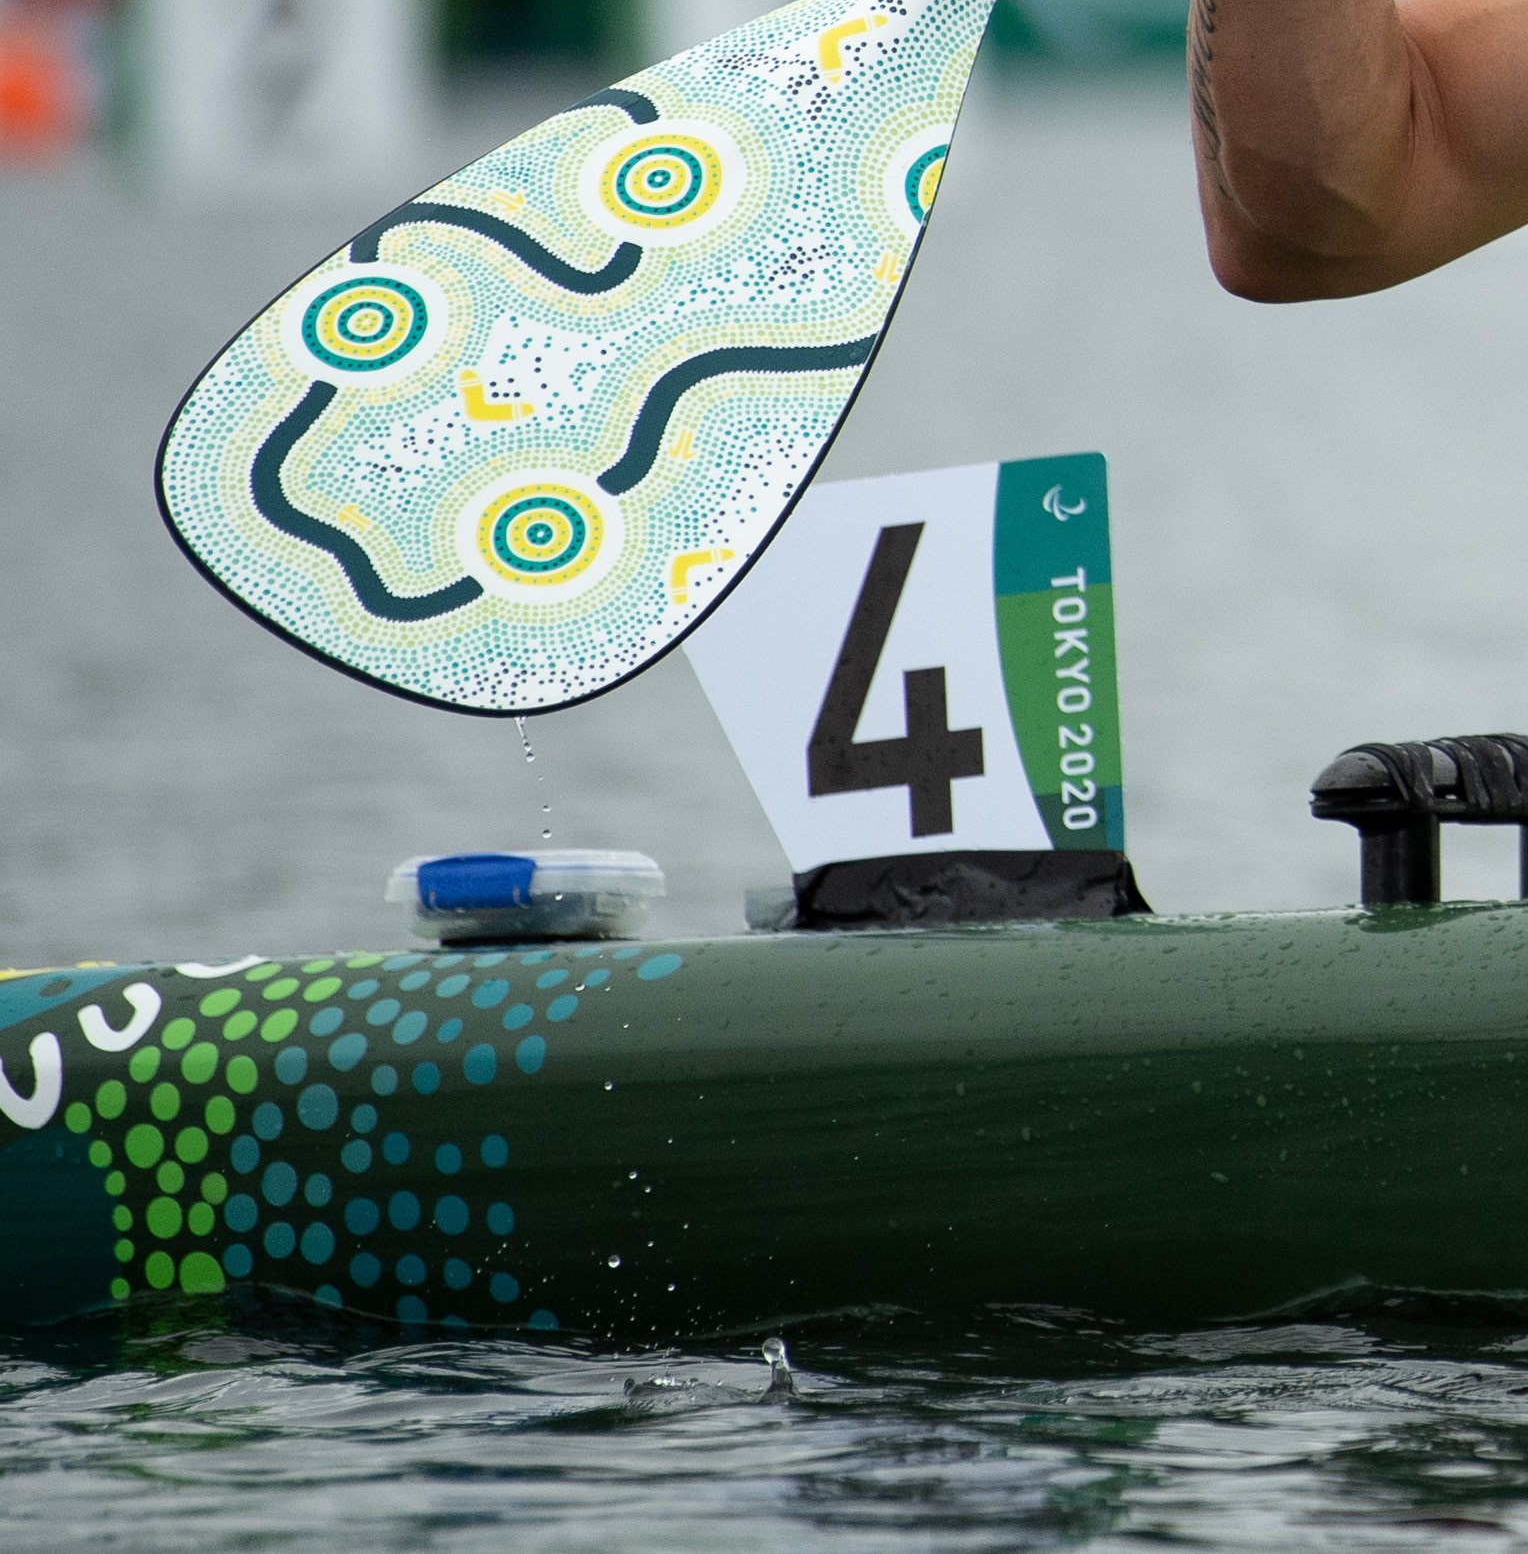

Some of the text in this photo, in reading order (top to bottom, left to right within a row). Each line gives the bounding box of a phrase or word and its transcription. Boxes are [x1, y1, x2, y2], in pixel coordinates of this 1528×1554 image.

[806, 520, 985, 839] 4
[1049, 566, 1099, 831] TOKYO 2020
